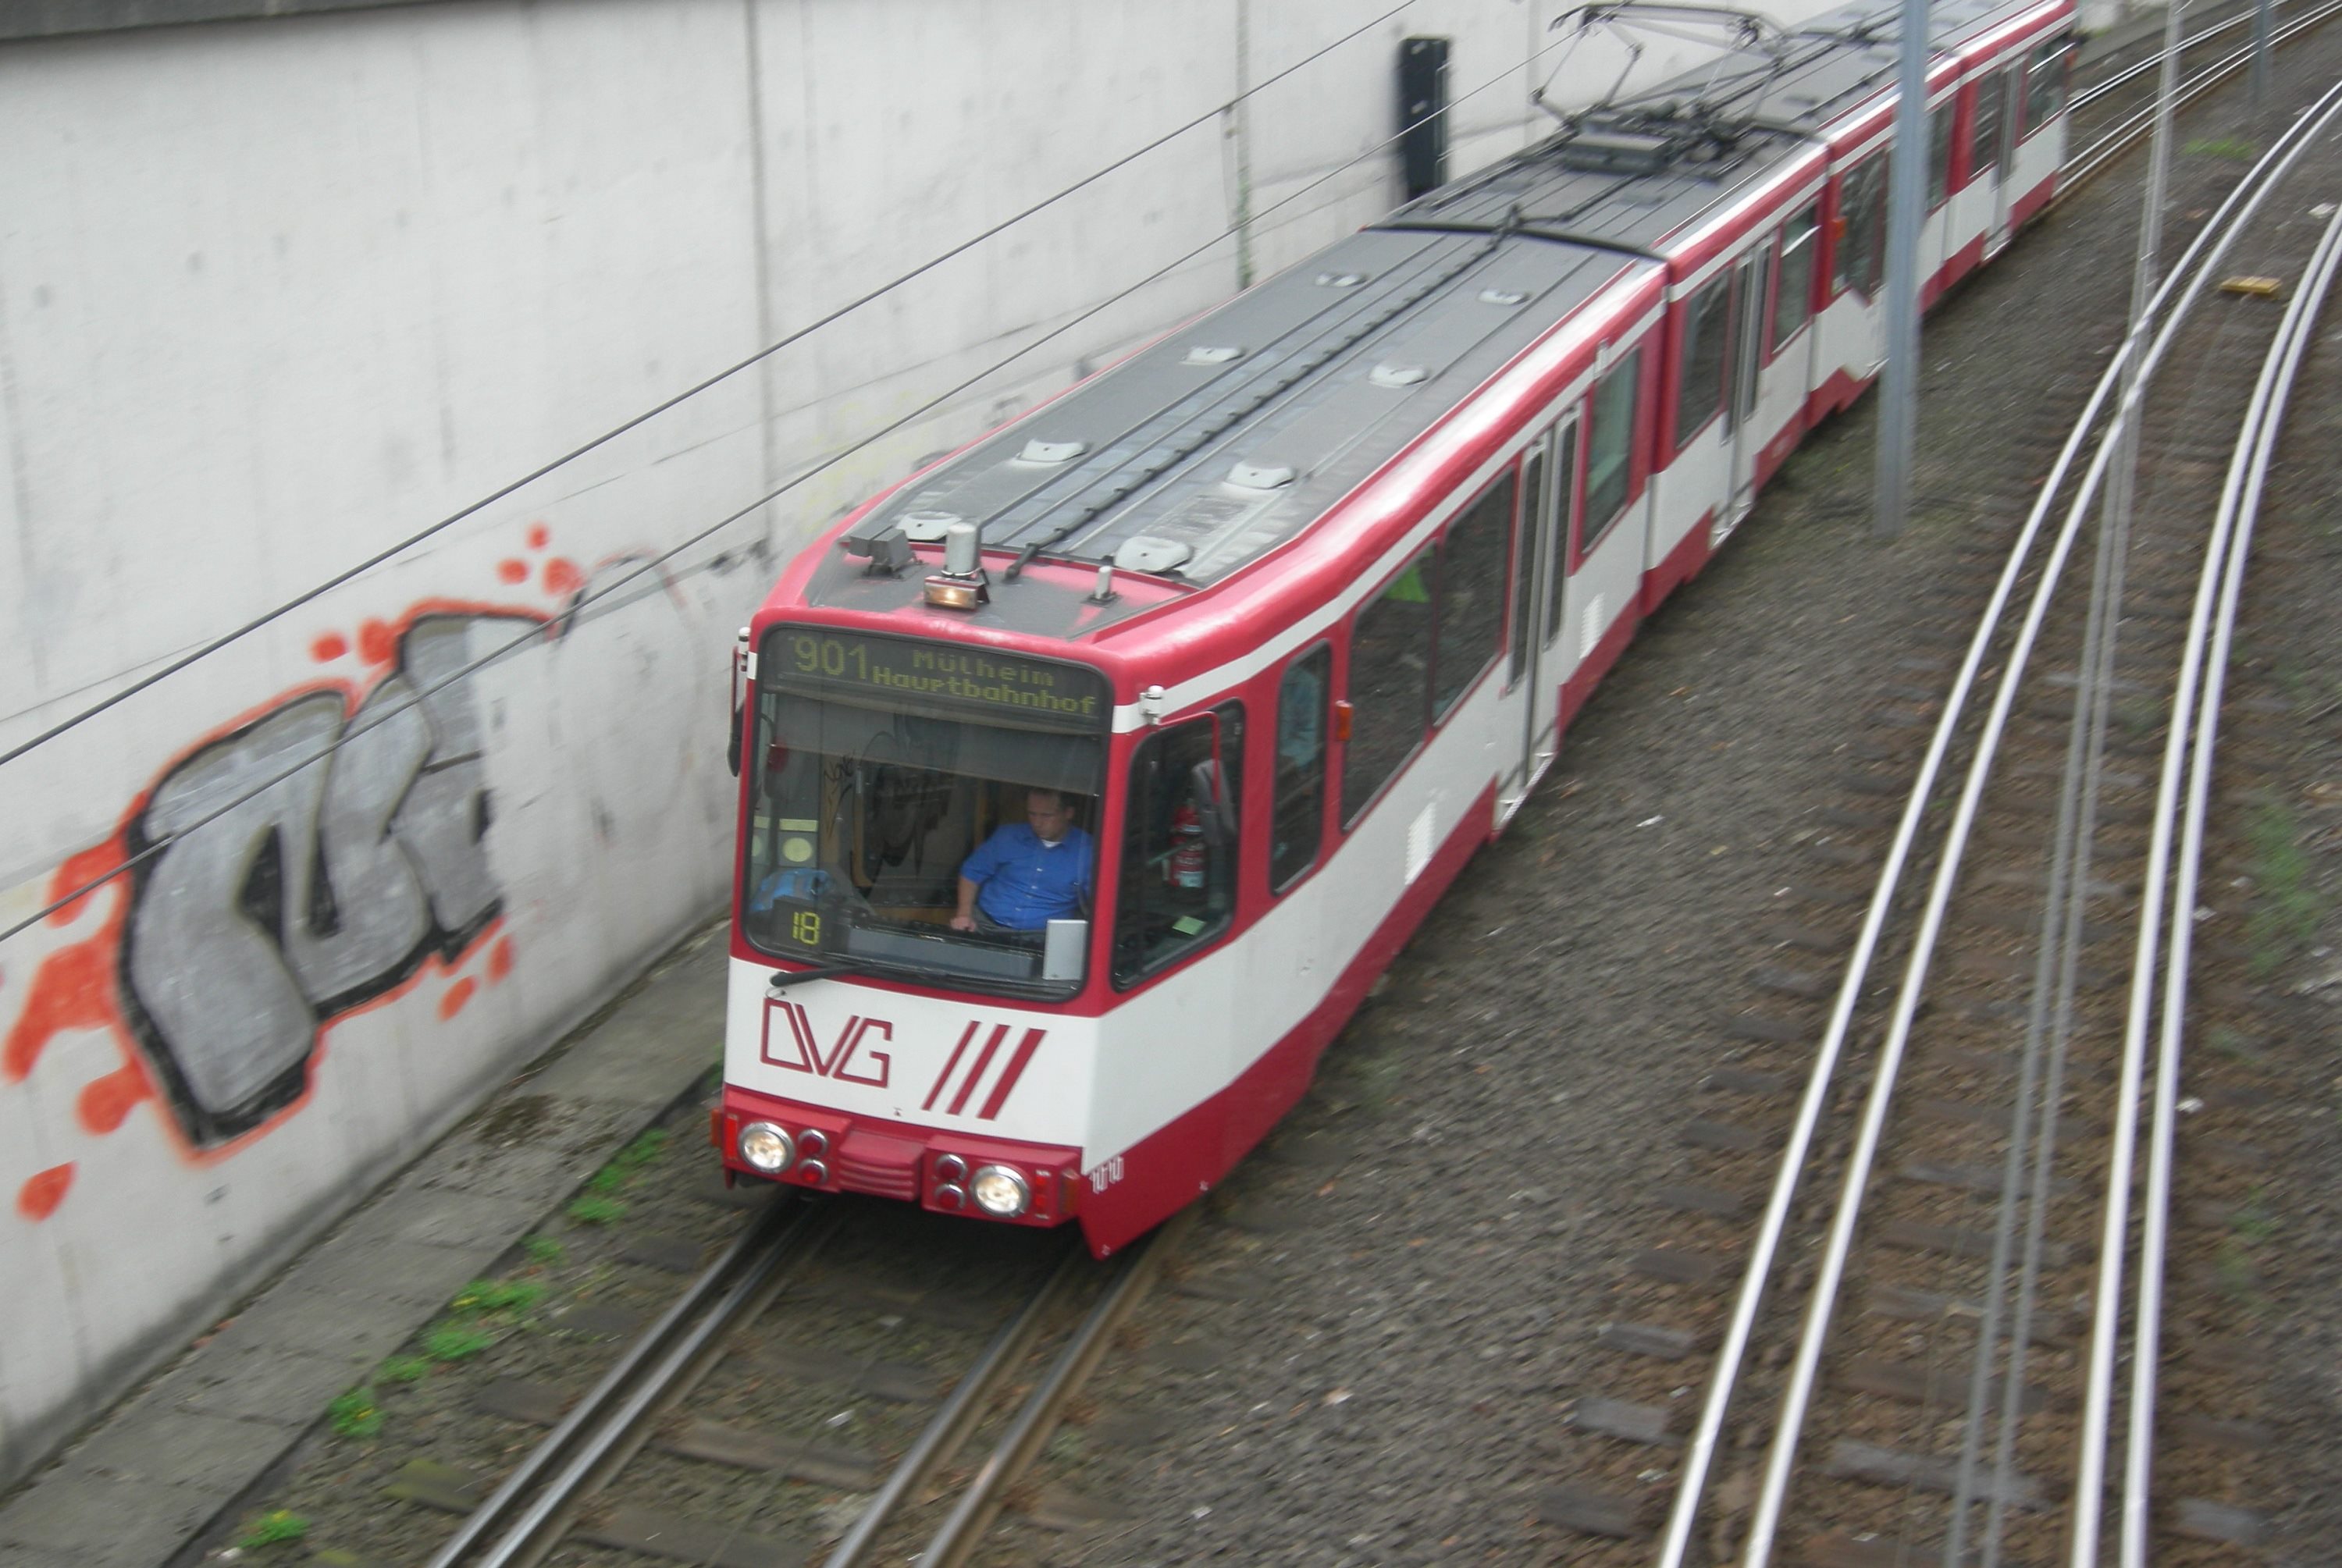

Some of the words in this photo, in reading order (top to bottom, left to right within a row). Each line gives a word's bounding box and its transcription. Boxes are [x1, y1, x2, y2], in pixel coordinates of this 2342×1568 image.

[795, 635, 867, 681] 901
[913, 649, 1055, 687] Mülheim
[872, 666, 1097, 714] Hauptbahnhof
[792, 911, 820, 946] 18
[760, 997, 893, 1089] DVG
